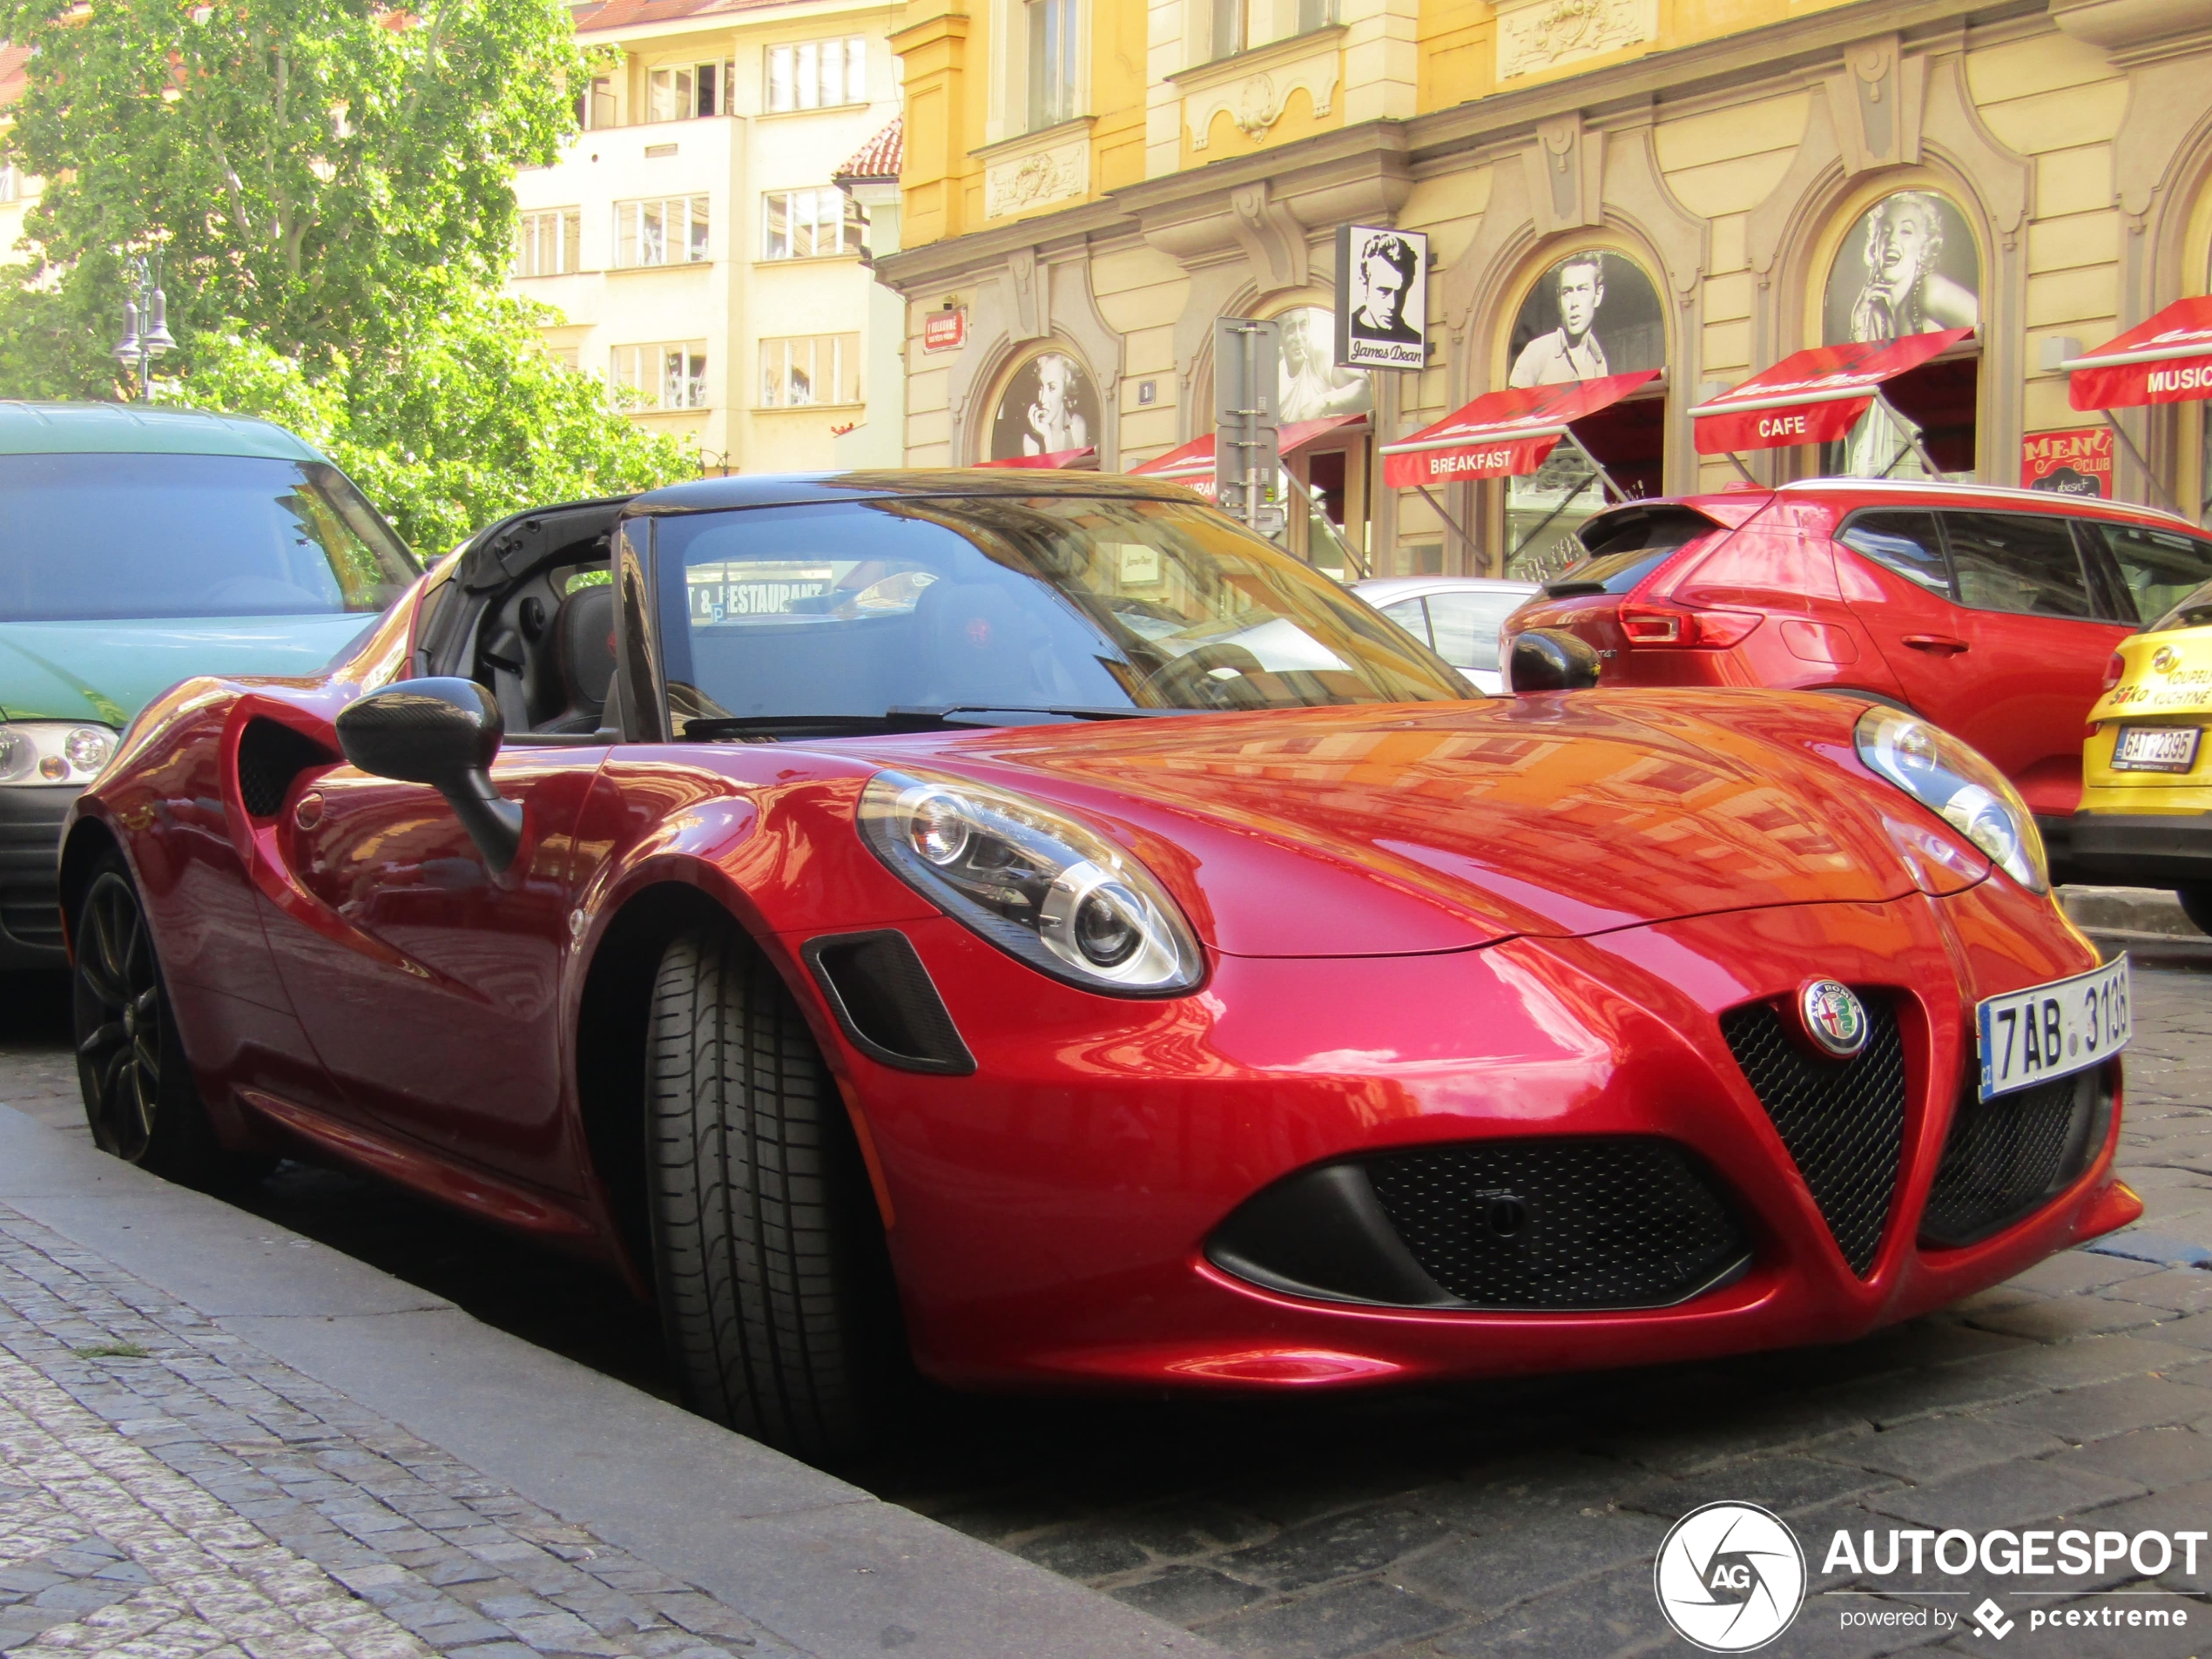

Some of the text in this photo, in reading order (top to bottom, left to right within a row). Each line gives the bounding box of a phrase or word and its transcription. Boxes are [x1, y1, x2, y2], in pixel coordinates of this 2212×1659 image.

[1351, 341, 1421, 362] James Dean
[1143, 385, 1149, 399] 1
[2147, 366, 2212, 393] MUSIC
[1758, 415, 1805, 437] CAFE
[2023, 428, 2113, 462] MENU
[1430, 450, 1511, 475] BREAKFAST
[2082, 457, 2110, 472] CLUB
[2155, 732, 2190, 759] 2395
[1811, 990, 1824, 1019] ALFA
[1997, 997, 2061, 1080] 7AB
[1981, 1064, 1992, 1087] CZ
